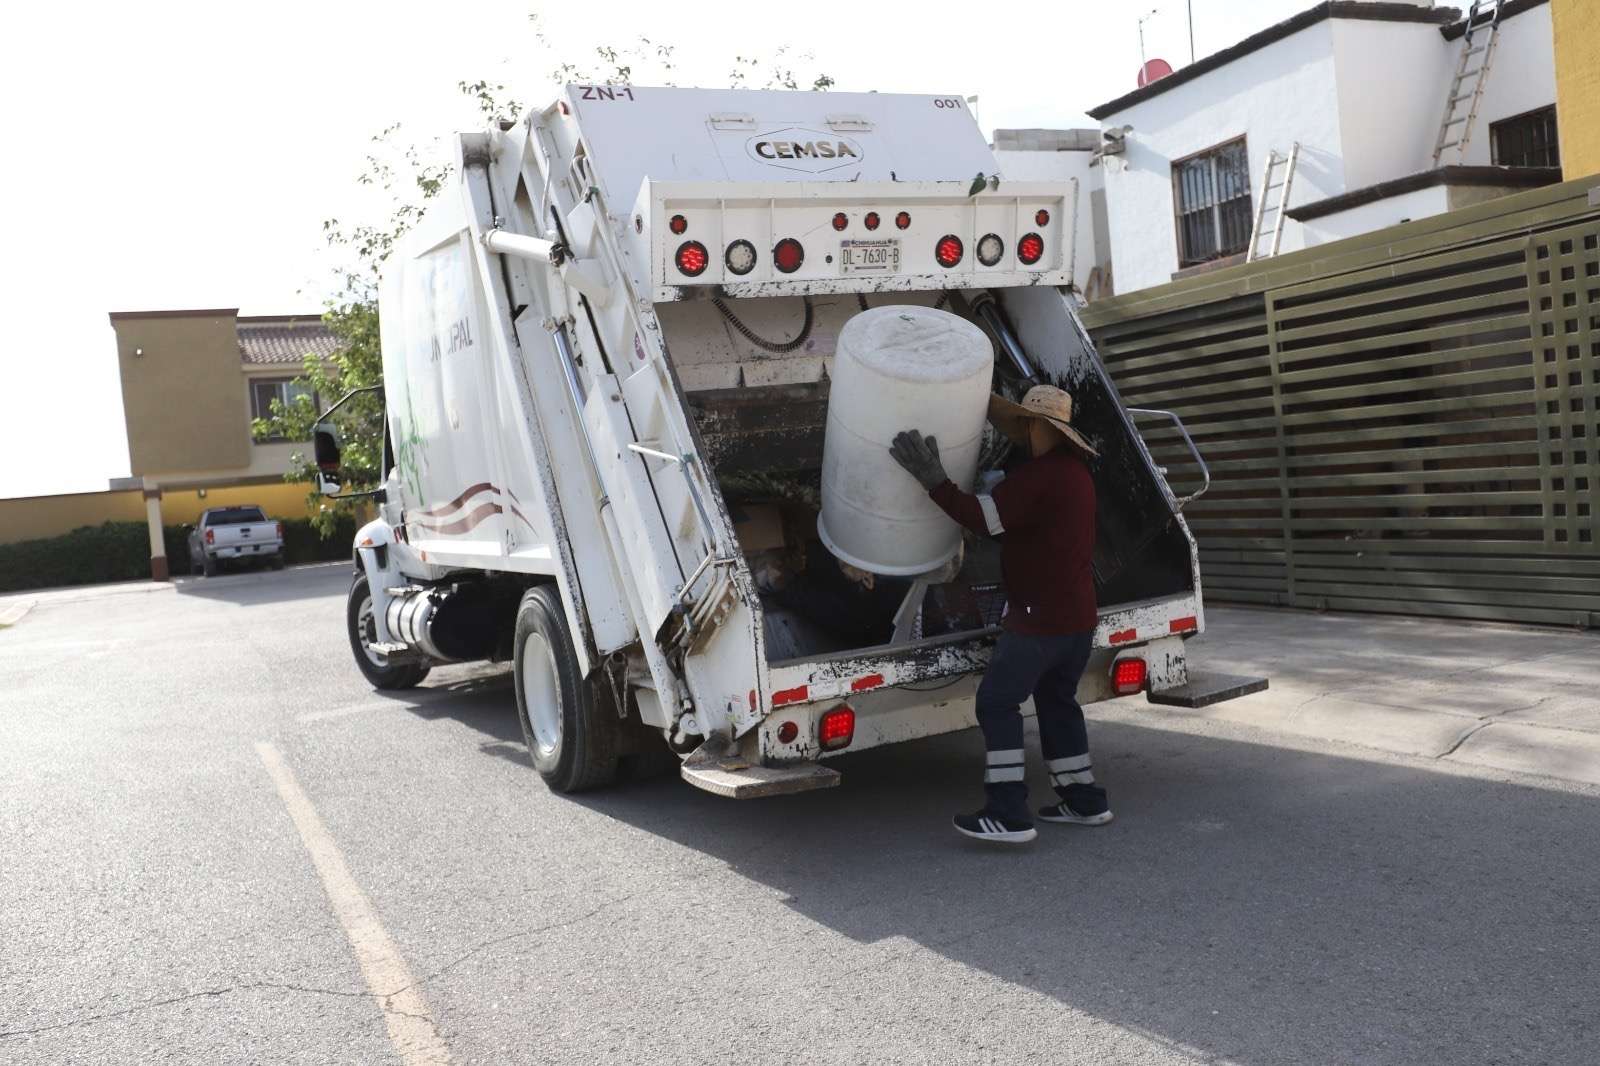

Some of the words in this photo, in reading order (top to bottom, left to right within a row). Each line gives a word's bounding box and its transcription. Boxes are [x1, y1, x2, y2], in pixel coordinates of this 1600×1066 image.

[579, 86, 635, 102] ZN-1
[934, 98, 961, 109] 001
[755, 141, 857, 160] CEMSA
[843, 248, 899, 265] DL-7630-B
